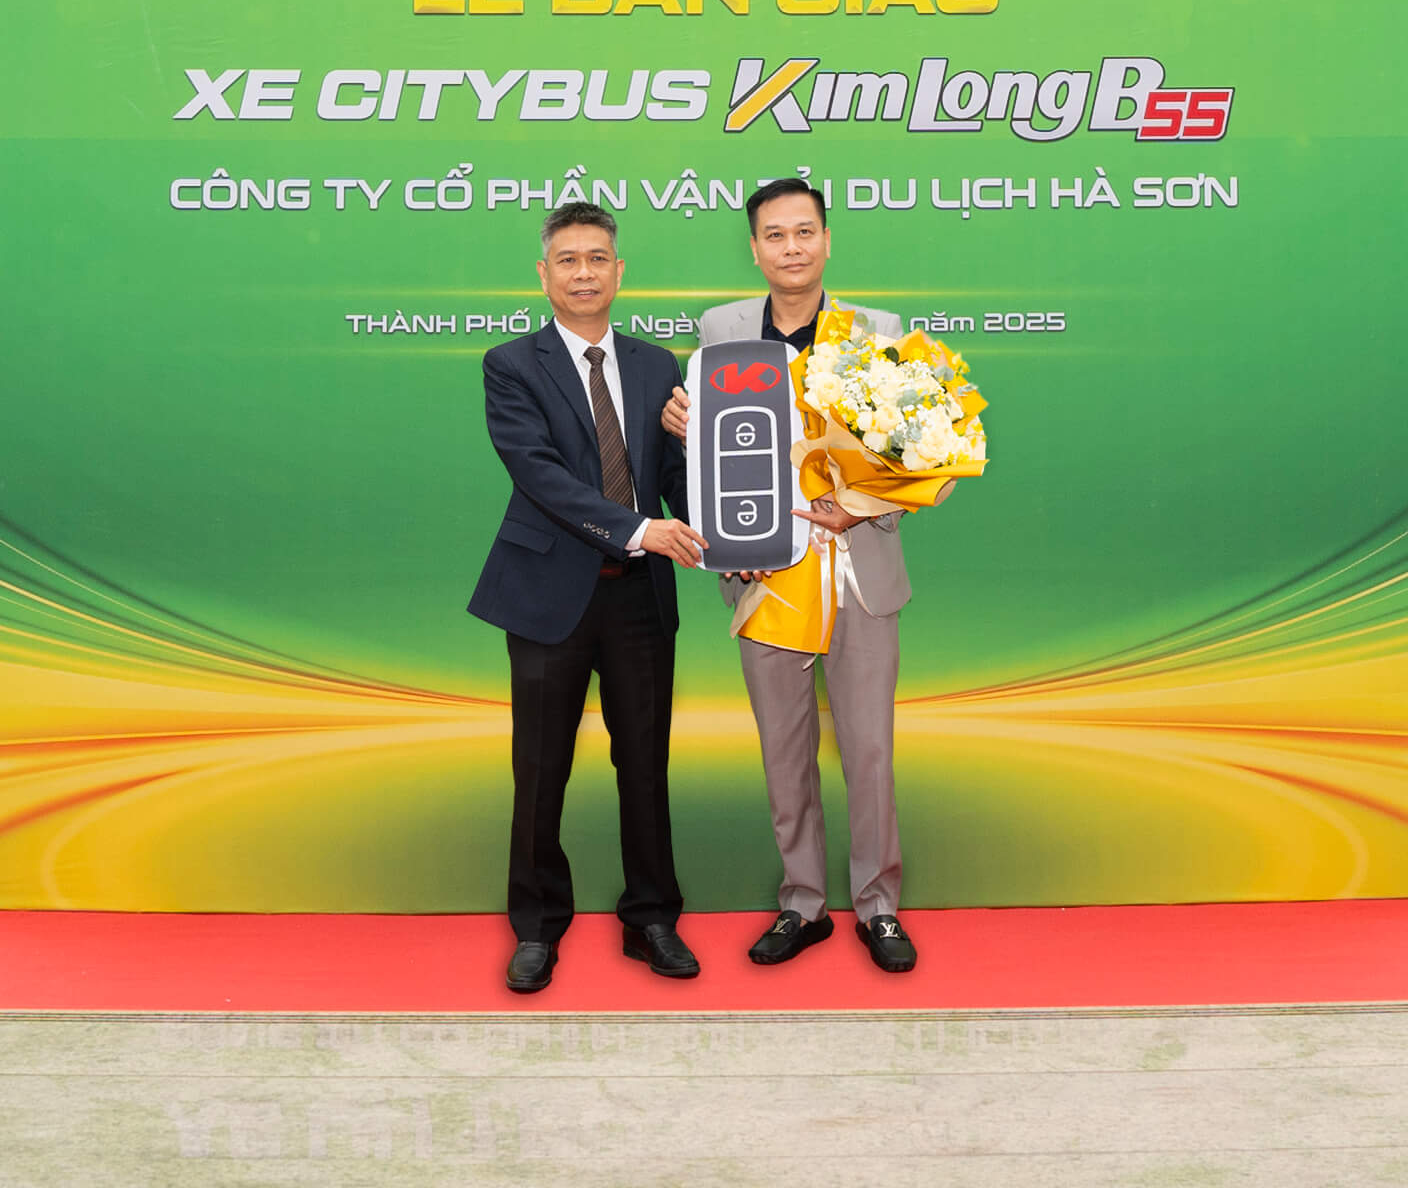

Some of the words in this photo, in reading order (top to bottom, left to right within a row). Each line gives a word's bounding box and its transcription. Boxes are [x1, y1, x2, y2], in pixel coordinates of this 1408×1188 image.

[172, 69, 301, 120] XE
[316, 69, 711, 120] CITYBUS
[169, 168, 311, 210] CÔNG
[323, 179, 392, 210] TY
[404, 164, 474, 210] CỔ
[487, 164, 627, 210] PHẦN
[640, 169, 744, 217] VẬN
[847, 178, 917, 210] DU
[931, 178, 1036, 219] LỊCH
[1050, 167, 1120, 208] HÀ
[1133, 175, 1238, 208] SƠN
[345, 309, 457, 334] THÀNH
[465, 307, 531, 334] PHỐ
[909, 311, 975, 333] năm
[983, 312, 1067, 333] 2025
